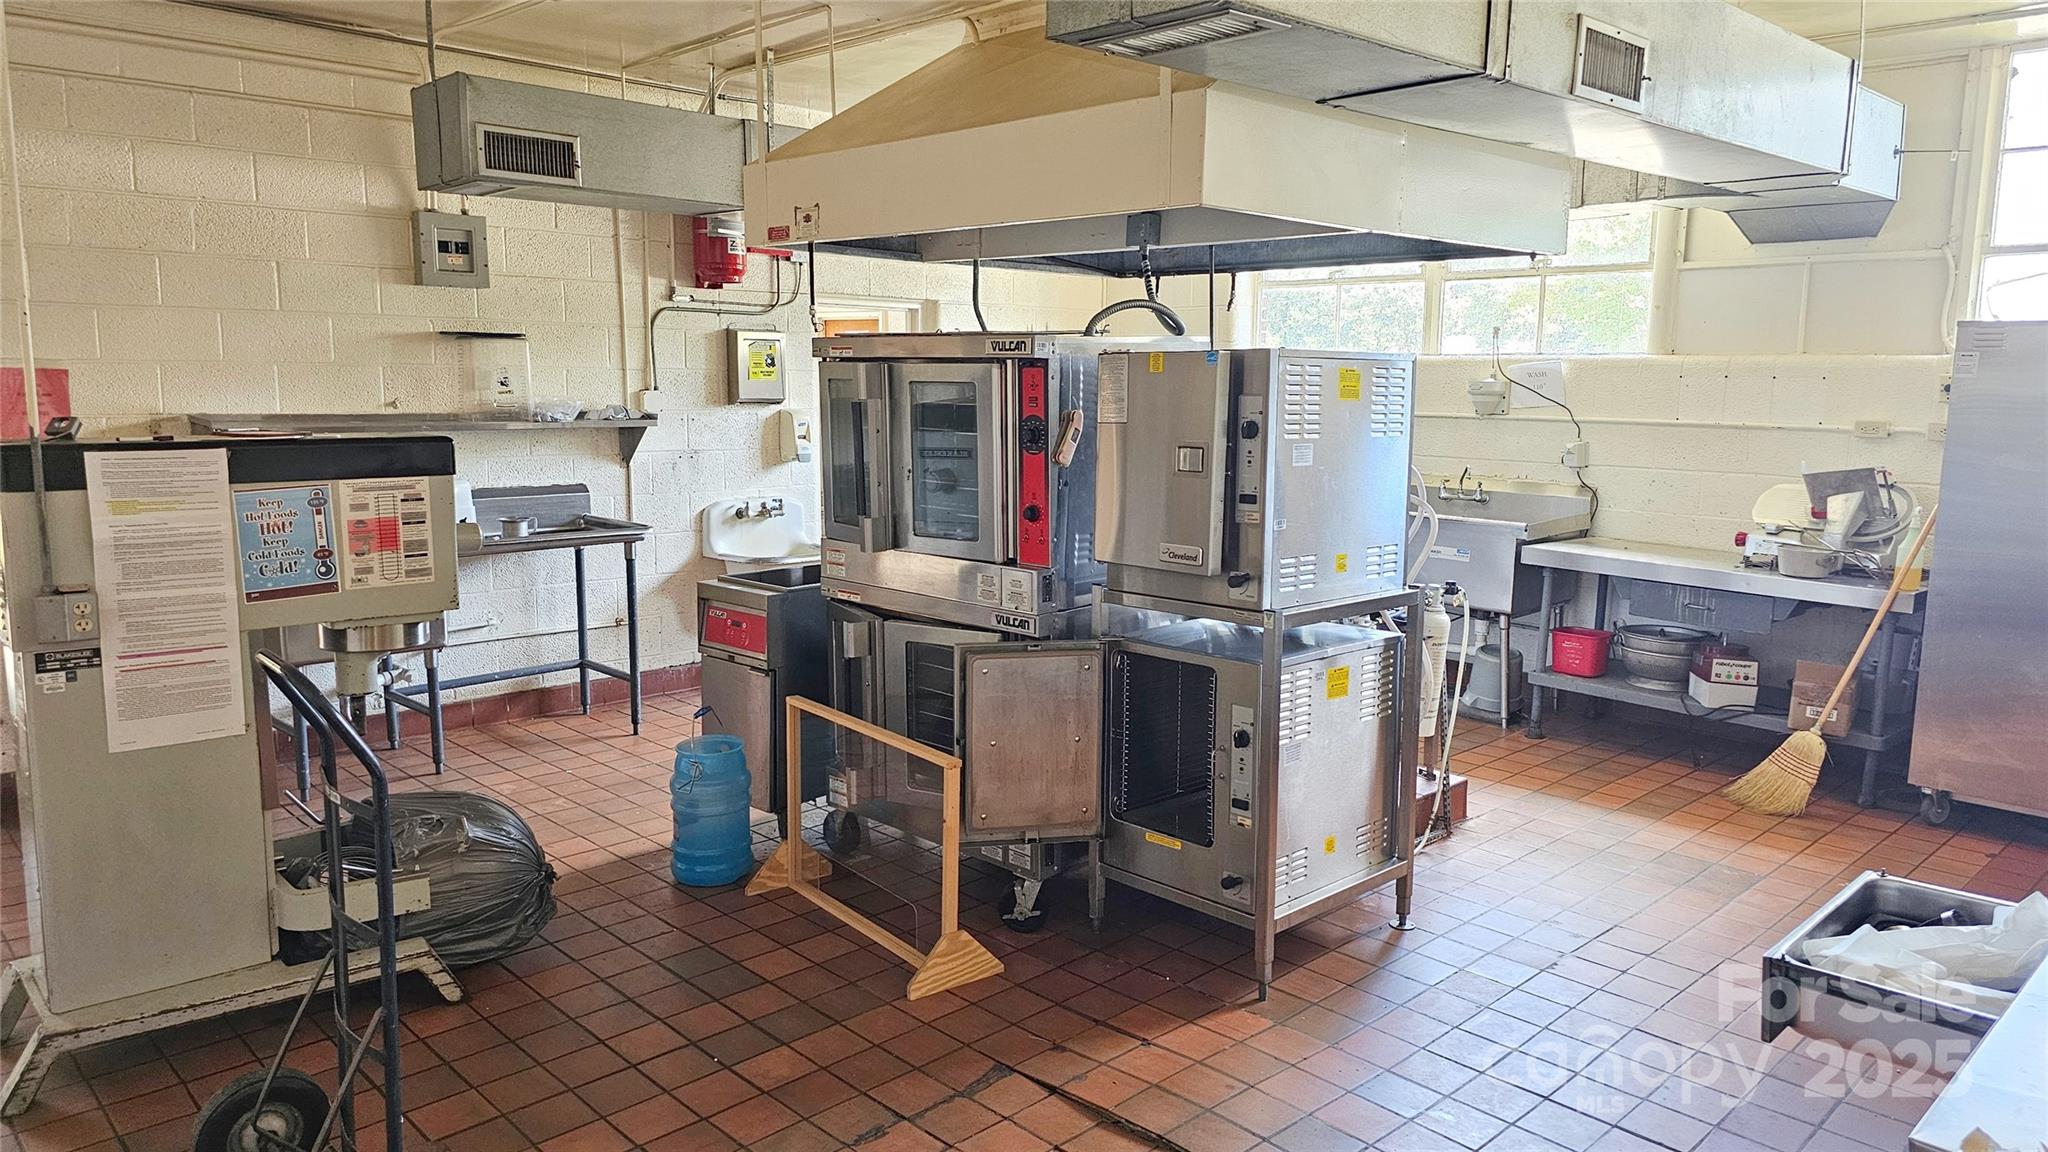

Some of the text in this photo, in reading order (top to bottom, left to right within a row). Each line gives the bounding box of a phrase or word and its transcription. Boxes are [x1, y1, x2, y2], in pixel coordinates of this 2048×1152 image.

[990, 340, 1027, 352] VULCAN
[257, 498, 284, 509] Keep
[245, 509, 299, 522] Hot Foods
[259, 520, 293, 536] Hot!
[262, 537, 289, 548] Keep
[247, 547, 305, 562] Cold Foods
[1168, 551, 1198, 562] Cleveland
[995, 614, 1030, 631] VULCAN
